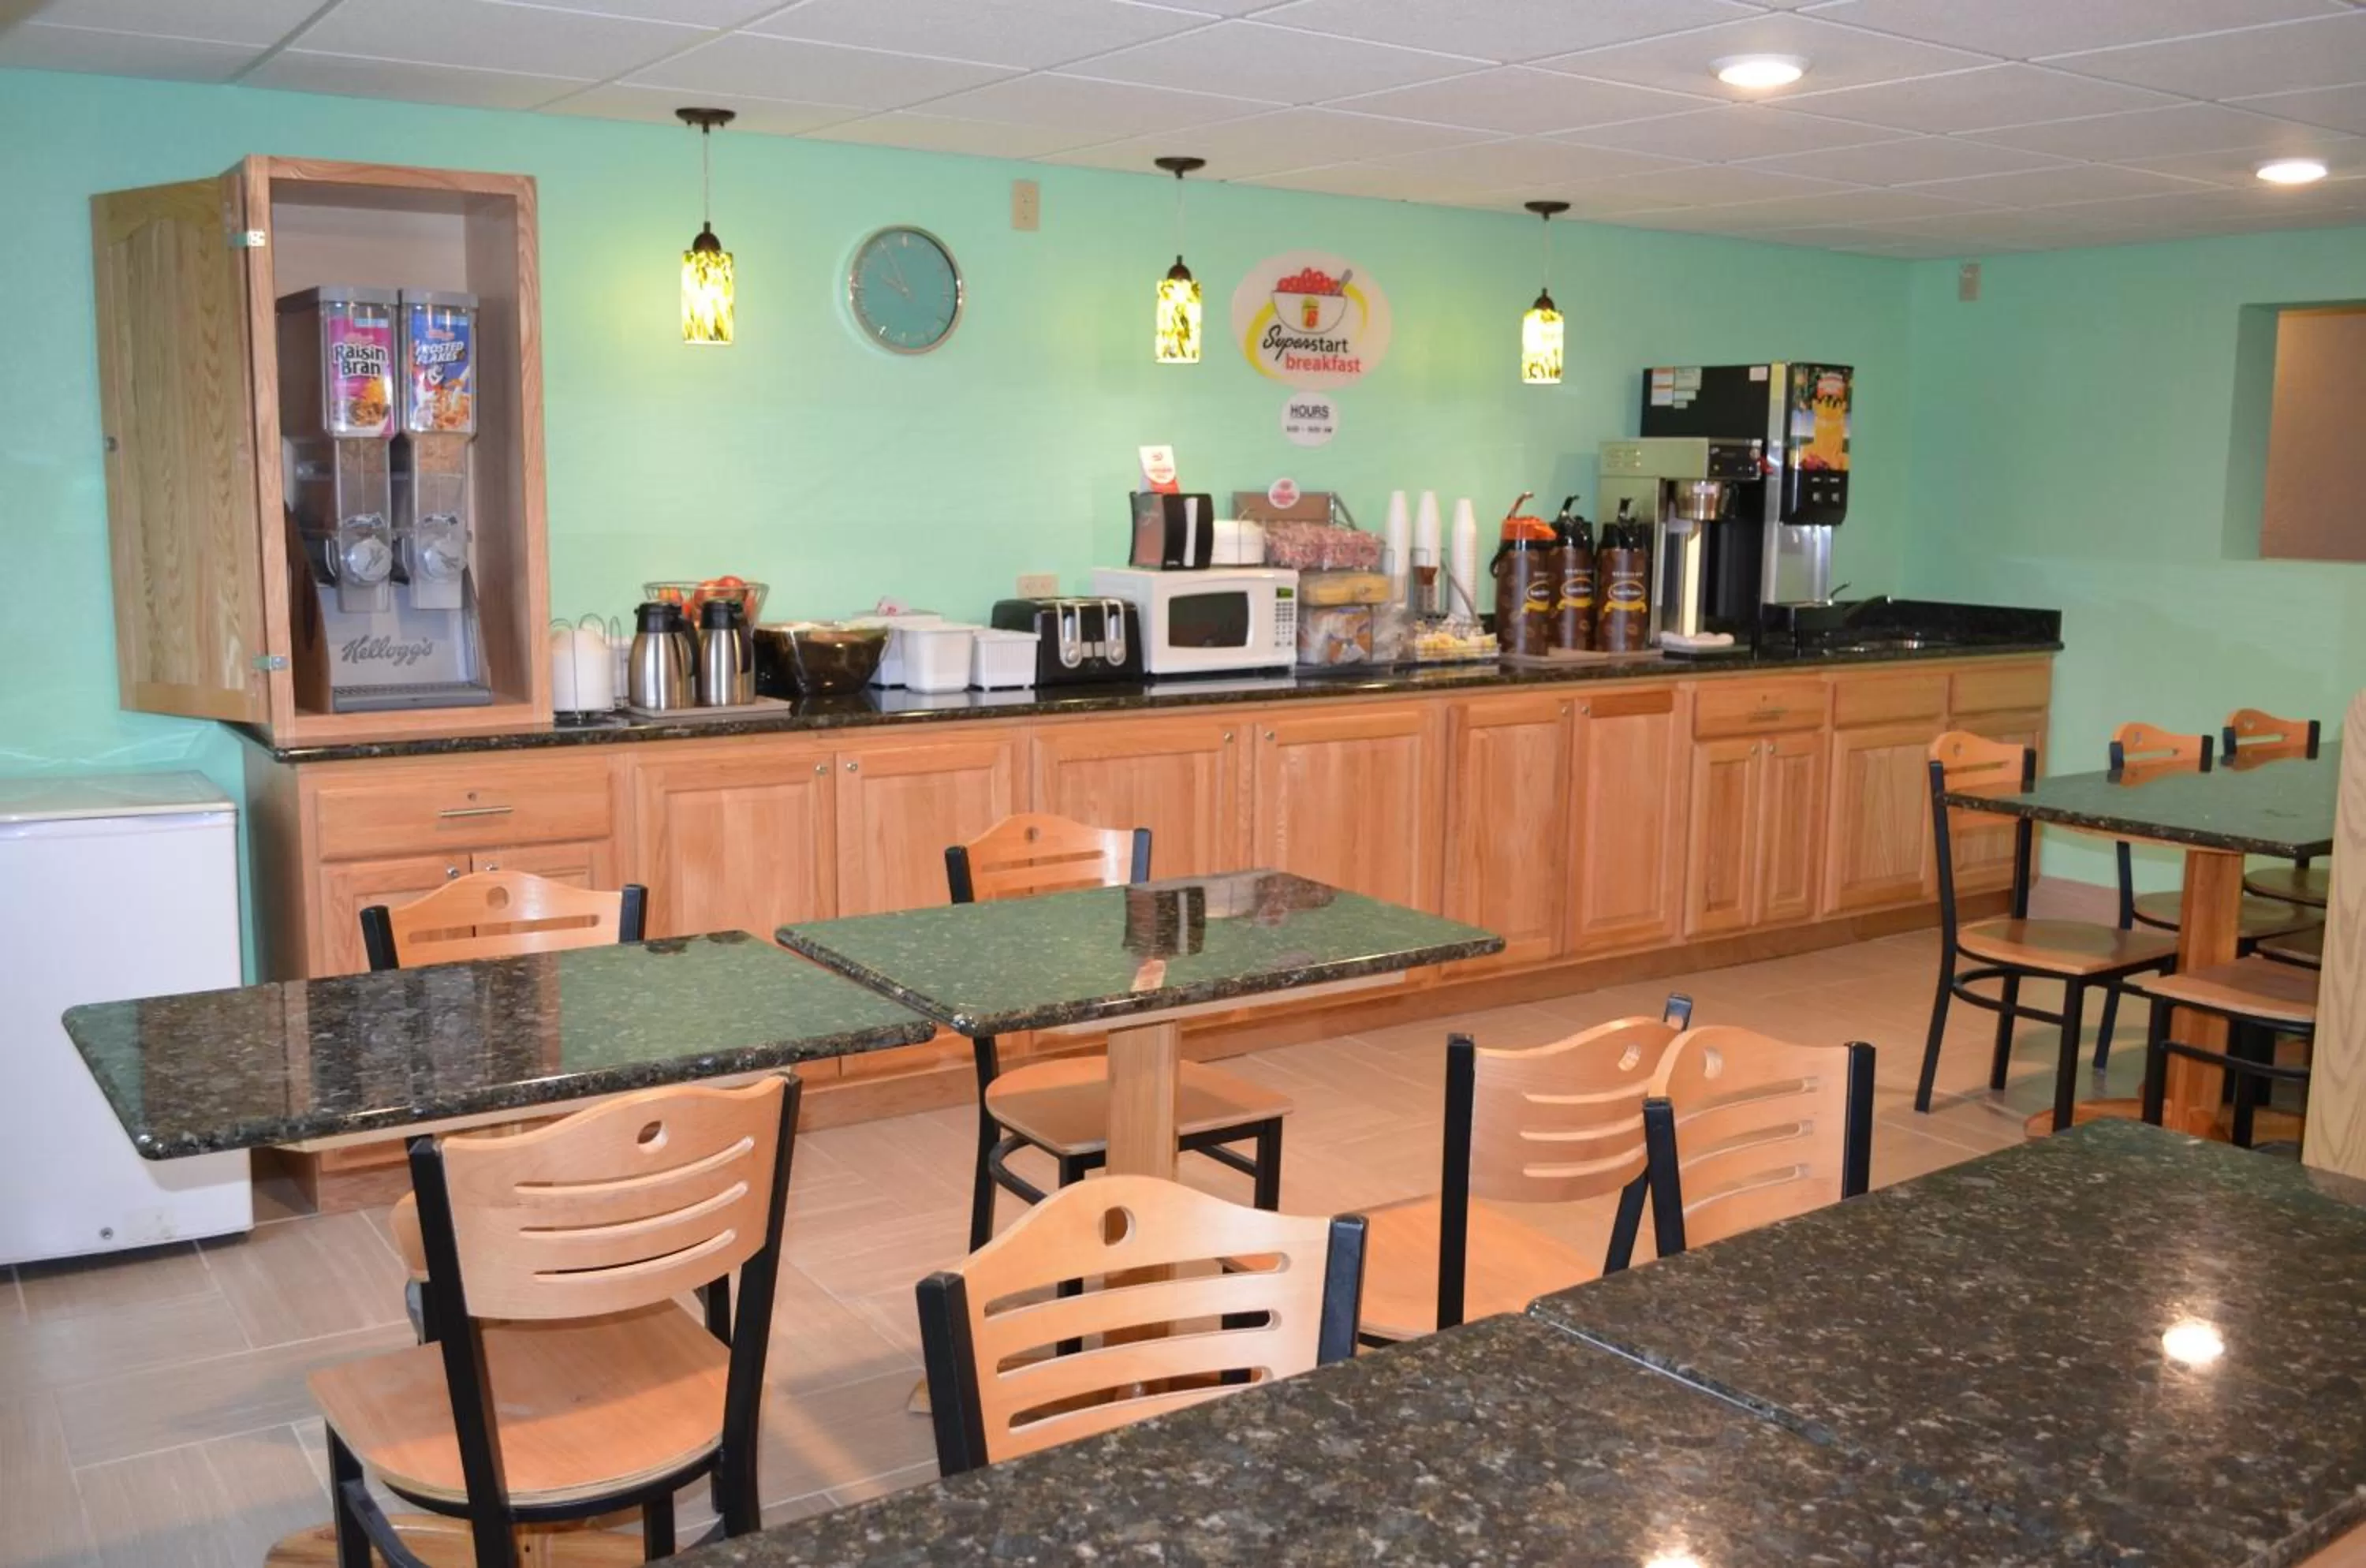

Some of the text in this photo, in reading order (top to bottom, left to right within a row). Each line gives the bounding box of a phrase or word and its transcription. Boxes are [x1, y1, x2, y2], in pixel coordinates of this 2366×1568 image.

[334, 343, 386, 361] Raisin
[341, 359, 381, 375] Bran
[1286, 353, 1361, 373] breakfast
[1289, 404, 1330, 418] HOURS
[341, 634, 434, 666] Kellogg's
